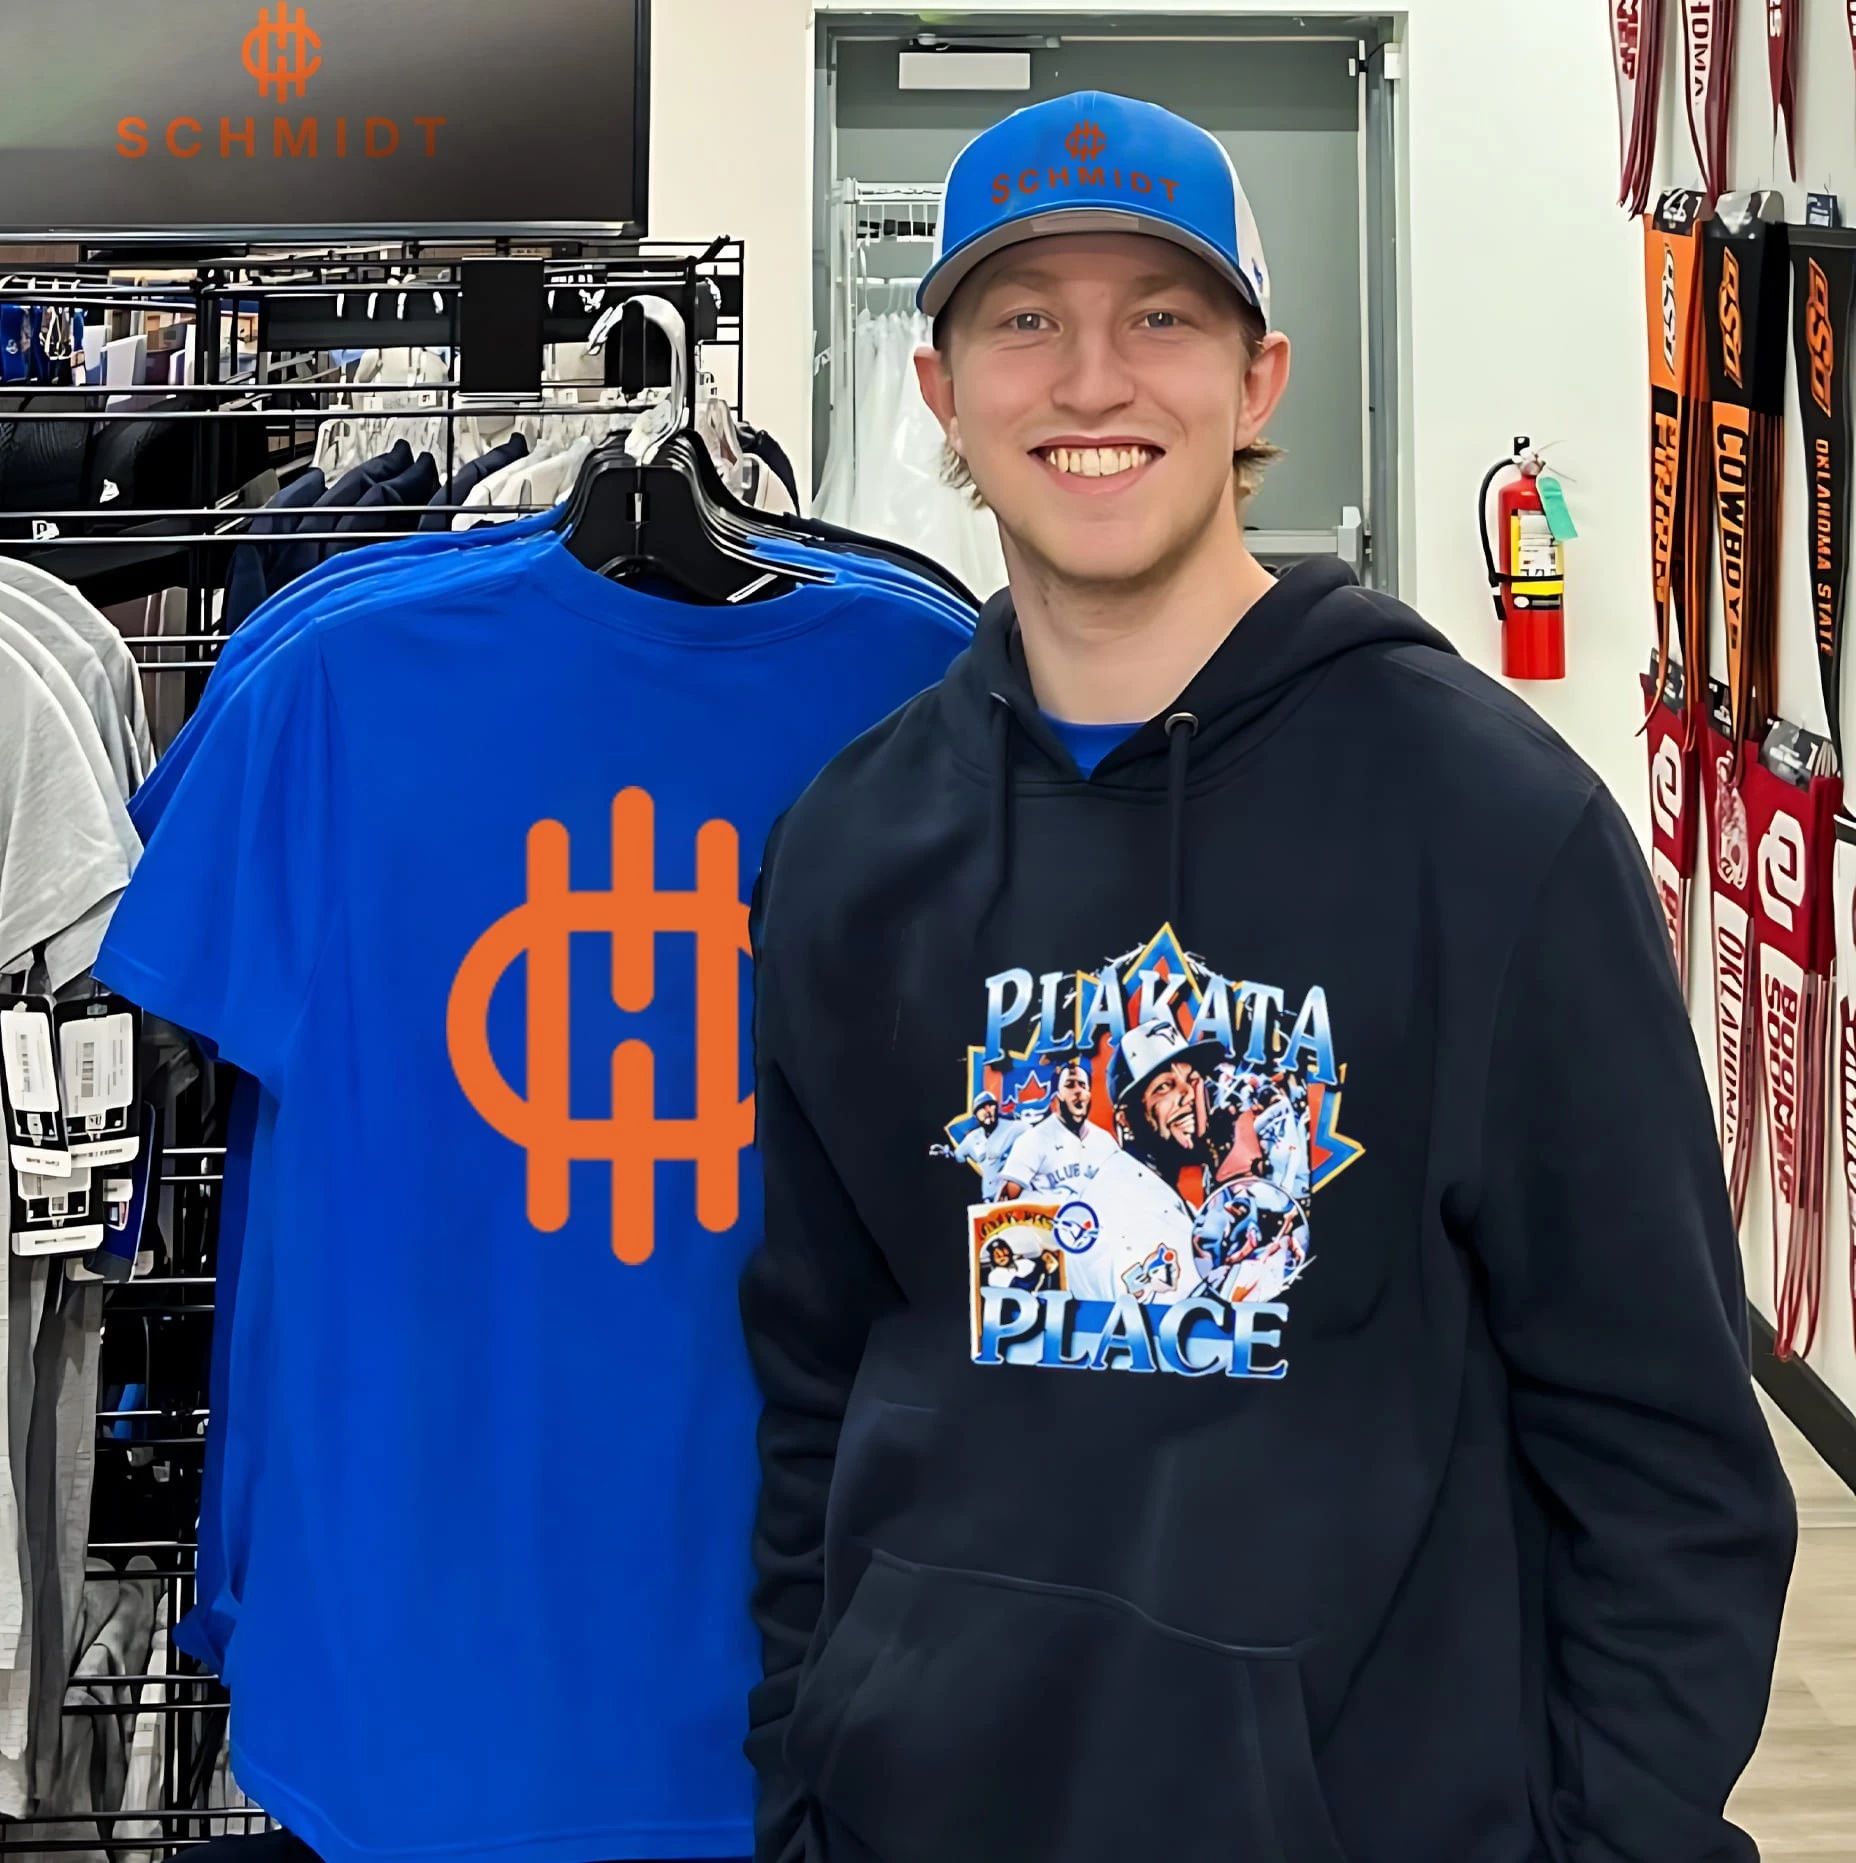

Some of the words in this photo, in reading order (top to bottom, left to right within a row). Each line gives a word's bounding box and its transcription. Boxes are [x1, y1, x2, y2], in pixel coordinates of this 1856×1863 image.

[115, 117, 447, 159] SCHMIDT
[992, 166, 1179, 204] SCHMIDT
[1814, 438, 1832, 569] OKLAHOMA
[983, 965, 1338, 1086] PLAKATA
[1718, 925, 1745, 1144] OKLAHOMA
[973, 1286, 1289, 1379] PLACE
